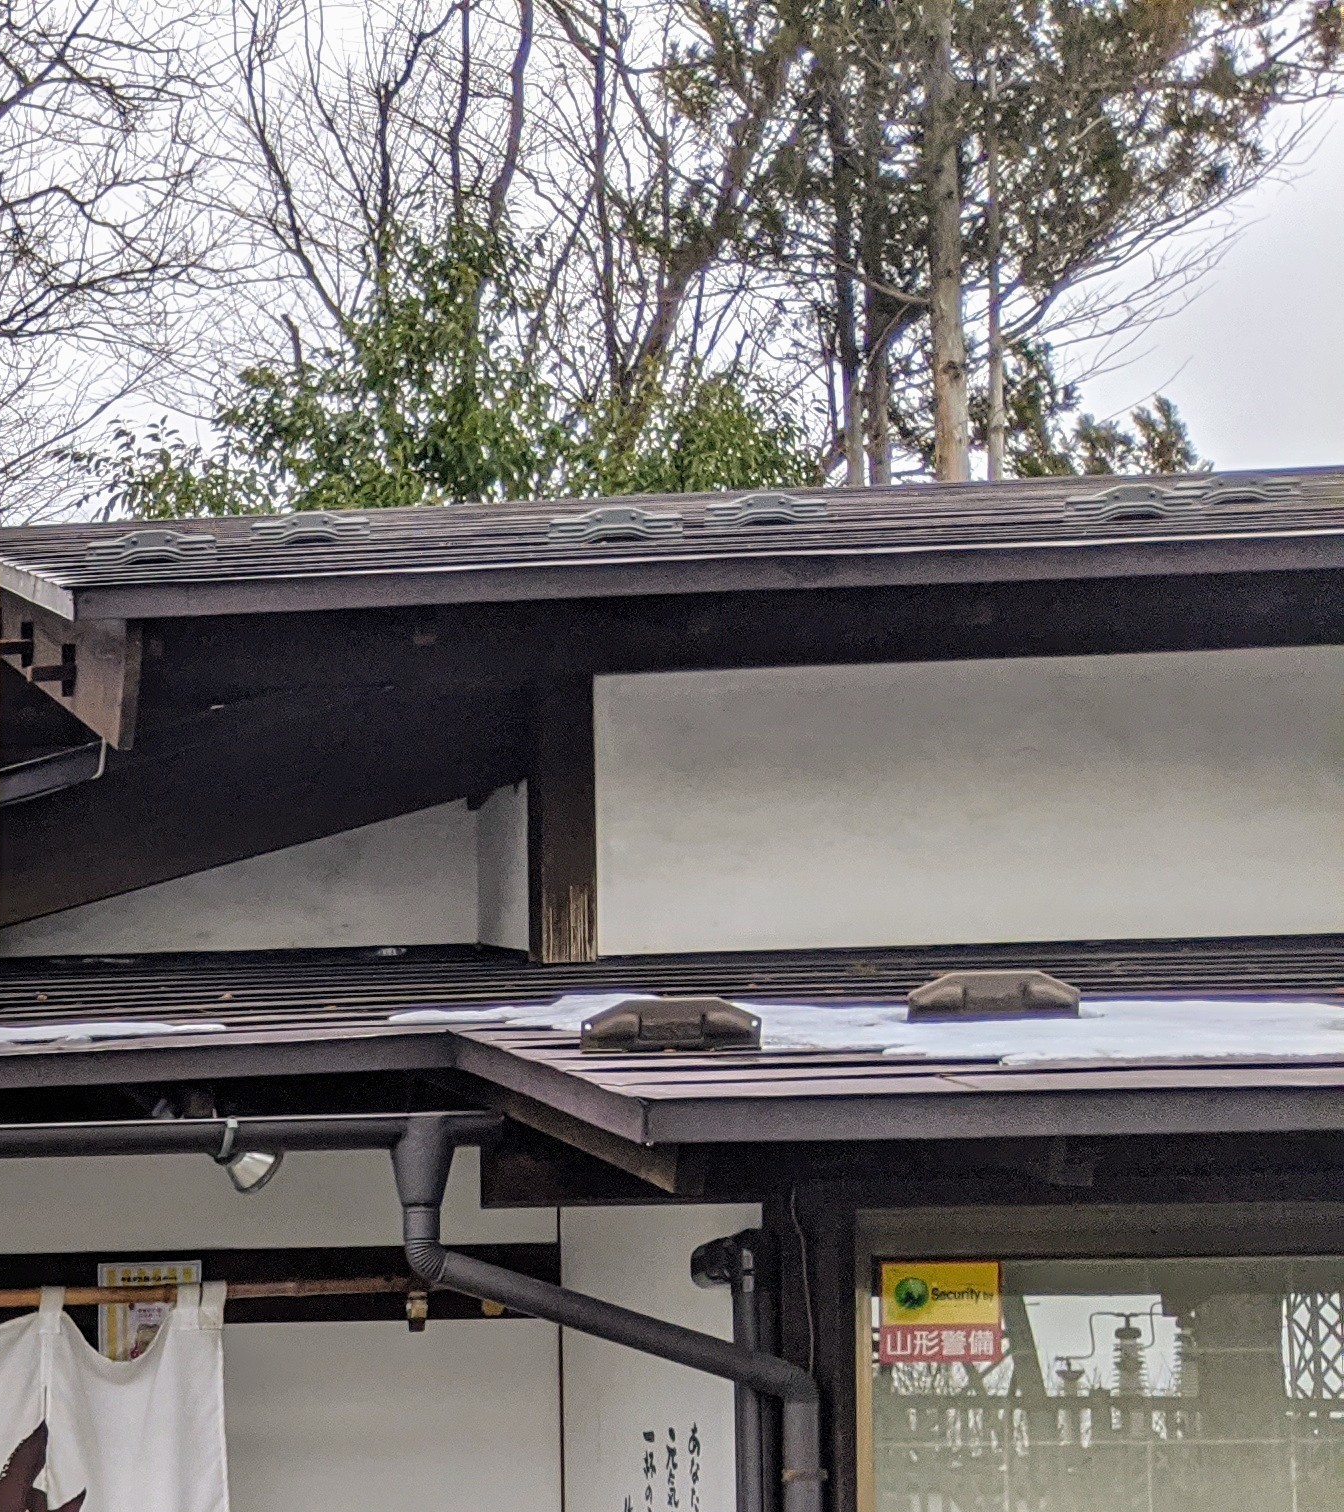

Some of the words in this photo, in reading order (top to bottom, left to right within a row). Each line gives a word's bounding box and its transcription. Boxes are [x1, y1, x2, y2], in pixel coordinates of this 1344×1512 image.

[930, 1287, 982, 1304] Security
[886, 1330, 995, 1356] 山形警備
